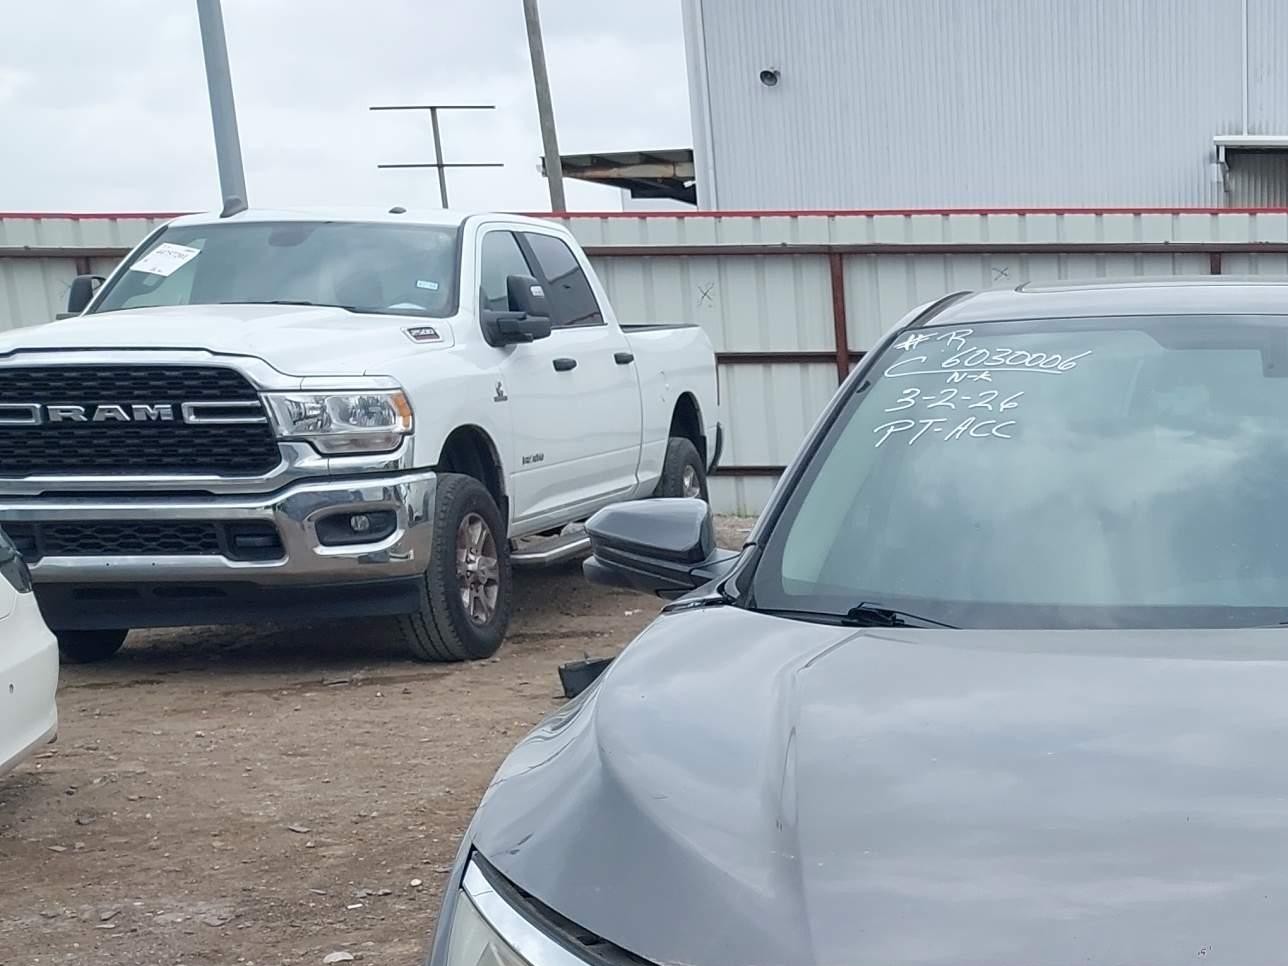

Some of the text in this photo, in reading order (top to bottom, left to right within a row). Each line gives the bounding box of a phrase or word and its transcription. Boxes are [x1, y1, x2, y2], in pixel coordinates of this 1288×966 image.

[941, 346, 1093, 371] 6030006
[884, 387, 1025, 413] 3-2-26
[46, 404, 174, 422] RAM
[873, 416, 1017, 448] PT-ACC
